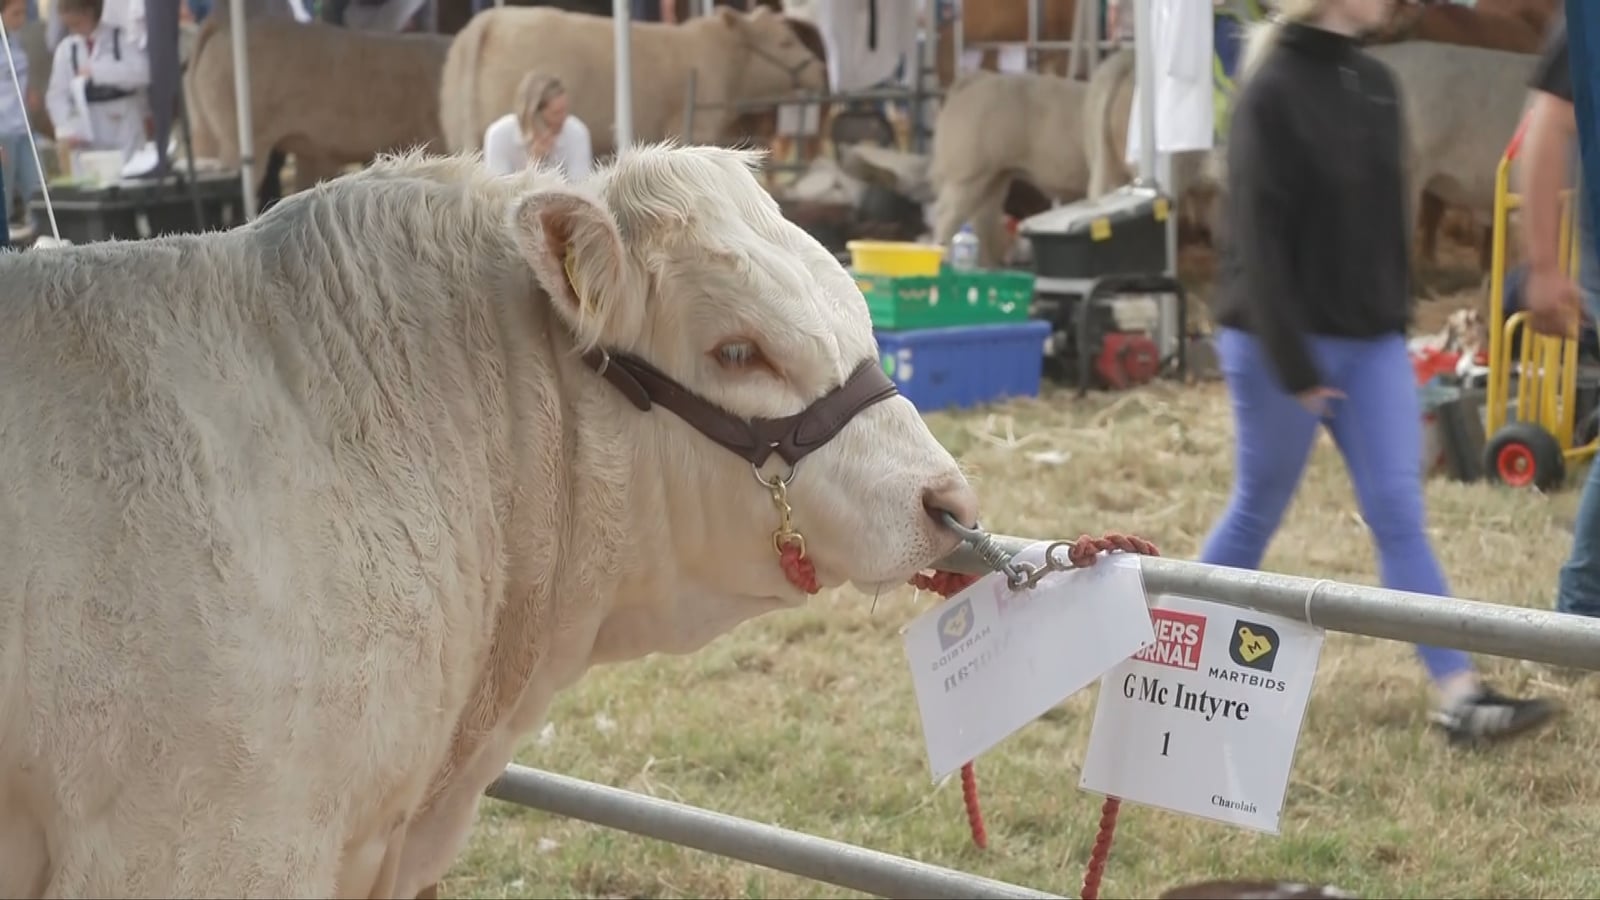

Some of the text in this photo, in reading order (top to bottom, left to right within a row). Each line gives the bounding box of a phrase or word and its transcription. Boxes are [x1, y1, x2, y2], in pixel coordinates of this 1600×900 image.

[1247, 641, 1261, 655] M
[1208, 667, 1286, 693] MARTBIDS
[1123, 673, 1250, 722] G Mc Intyre
[1160, 731, 1171, 757] 1
[1211, 794, 1258, 813] Charolais
